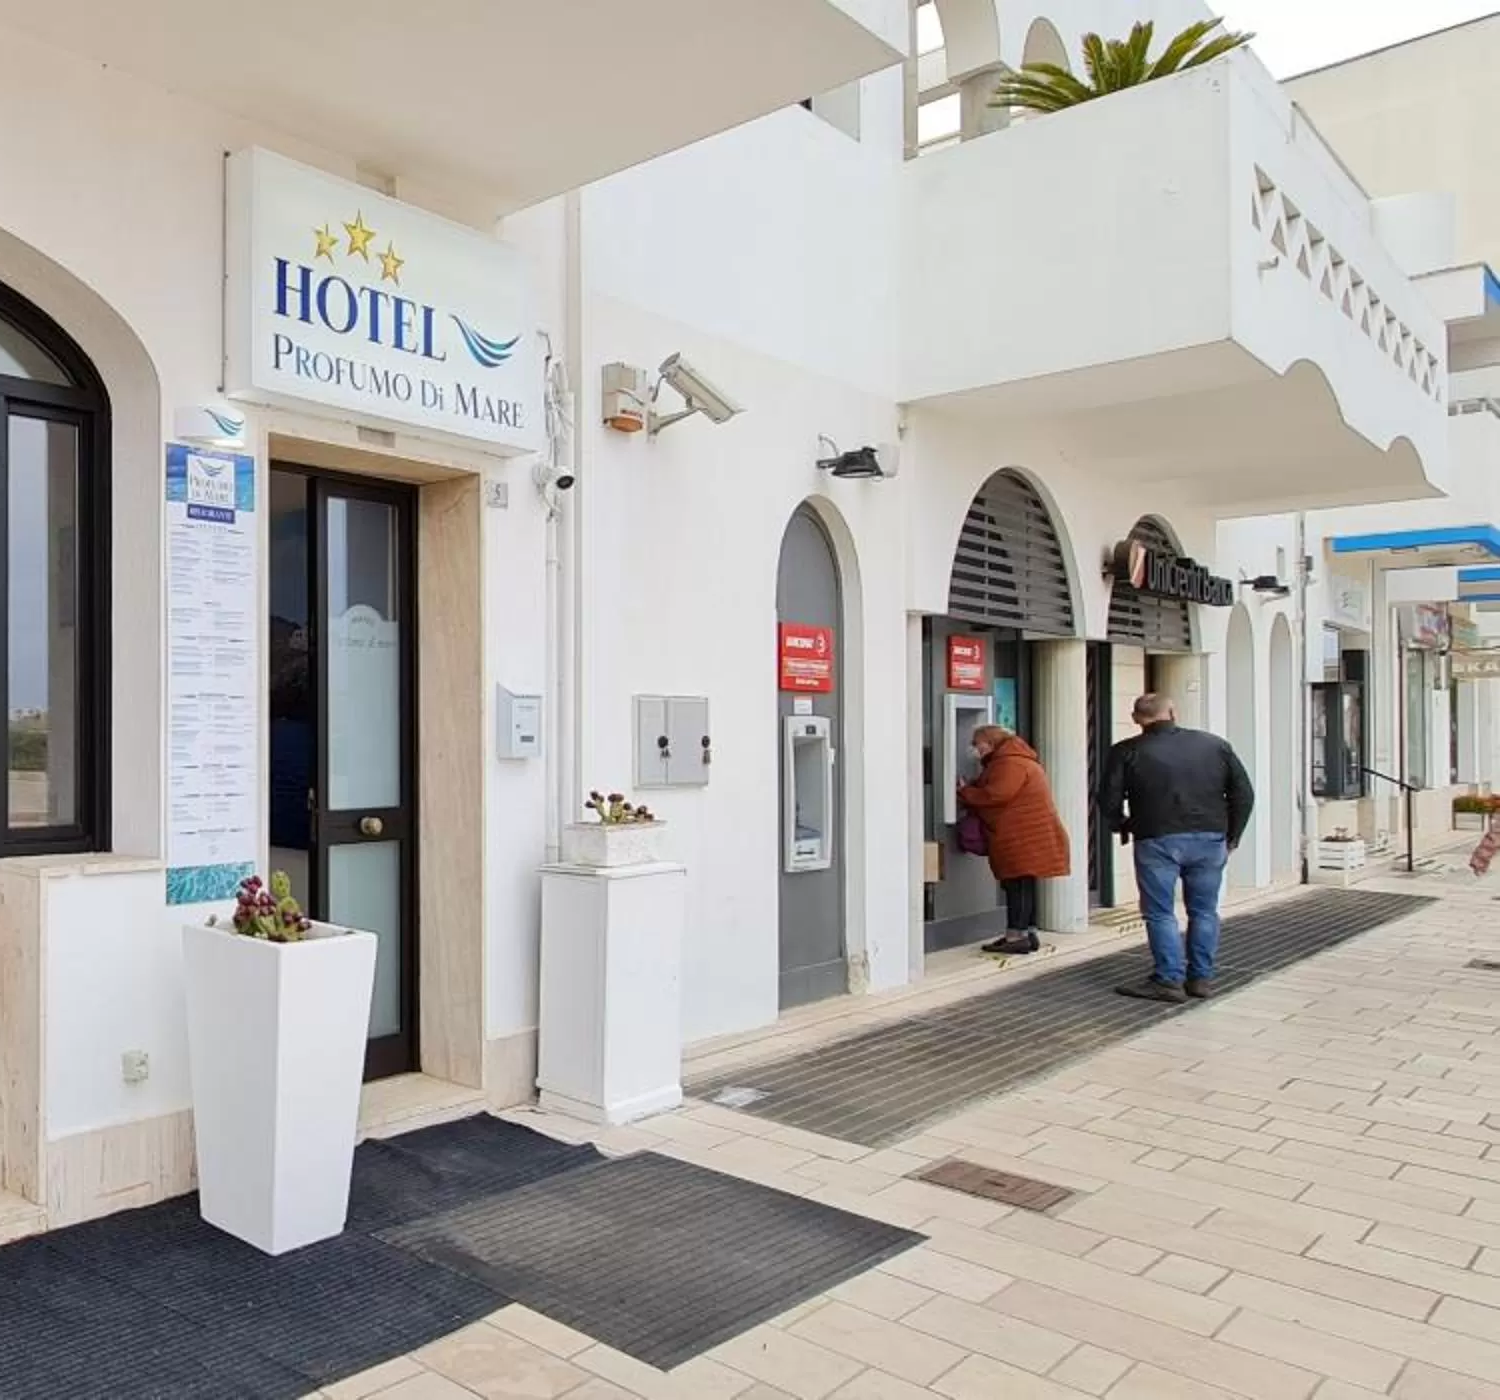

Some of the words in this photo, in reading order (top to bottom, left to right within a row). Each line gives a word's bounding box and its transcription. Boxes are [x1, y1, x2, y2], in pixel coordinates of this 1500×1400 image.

[273, 256, 447, 362] HOTEL
[273, 333, 412, 402] PROFUMO
[454, 383, 524, 429] MARE
